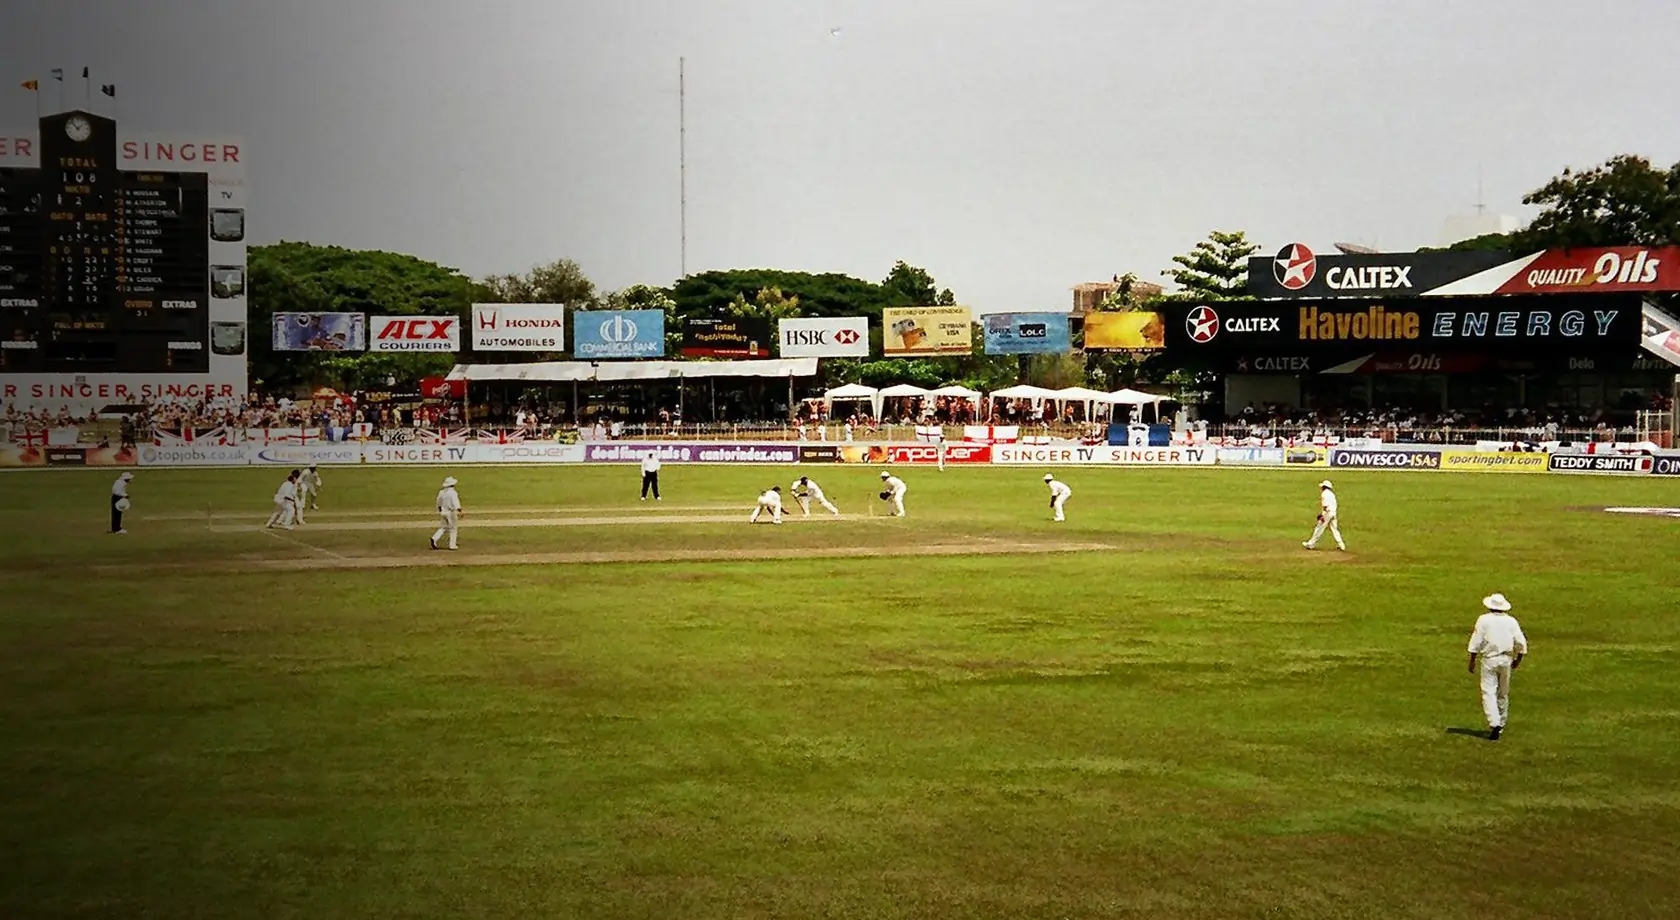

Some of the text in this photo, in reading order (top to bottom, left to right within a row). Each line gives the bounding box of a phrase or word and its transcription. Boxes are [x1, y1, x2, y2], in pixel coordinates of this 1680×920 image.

[123, 142, 239, 162] SINGER
[60, 157, 97, 168] TOTAL
[221, 191, 233, 200] TV
[1527, 250, 1661, 288] QUALITY Oils
[1326, 265, 1413, 291] CALTEX
[1, 298, 39, 308] EXTRAS
[161, 300, 198, 309] EXTRAS
[377, 319, 454, 340] ACX
[505, 319, 562, 328] HONDA
[1225, 306, 1618, 341] CALTEX Havoline ENERGY
[479, 338, 556, 347] AUTOMOBILES
[785, 328, 831, 346] HSBC
[379, 342, 452, 350] COURIERS
[1253, 356, 1312, 371] CALTEX
[31, 384, 128, 398] SINGER
[158, 447, 247, 463] topjobs.co.uk
[375, 448, 466, 461] SINGER TV
[1002, 448, 1095, 462] SINGER TV
[1111, 449, 1204, 462] SINGER TV
[1447, 452, 1544, 469] sportingbet.com
[1554, 456, 1633, 470] TEDDY SMITH
